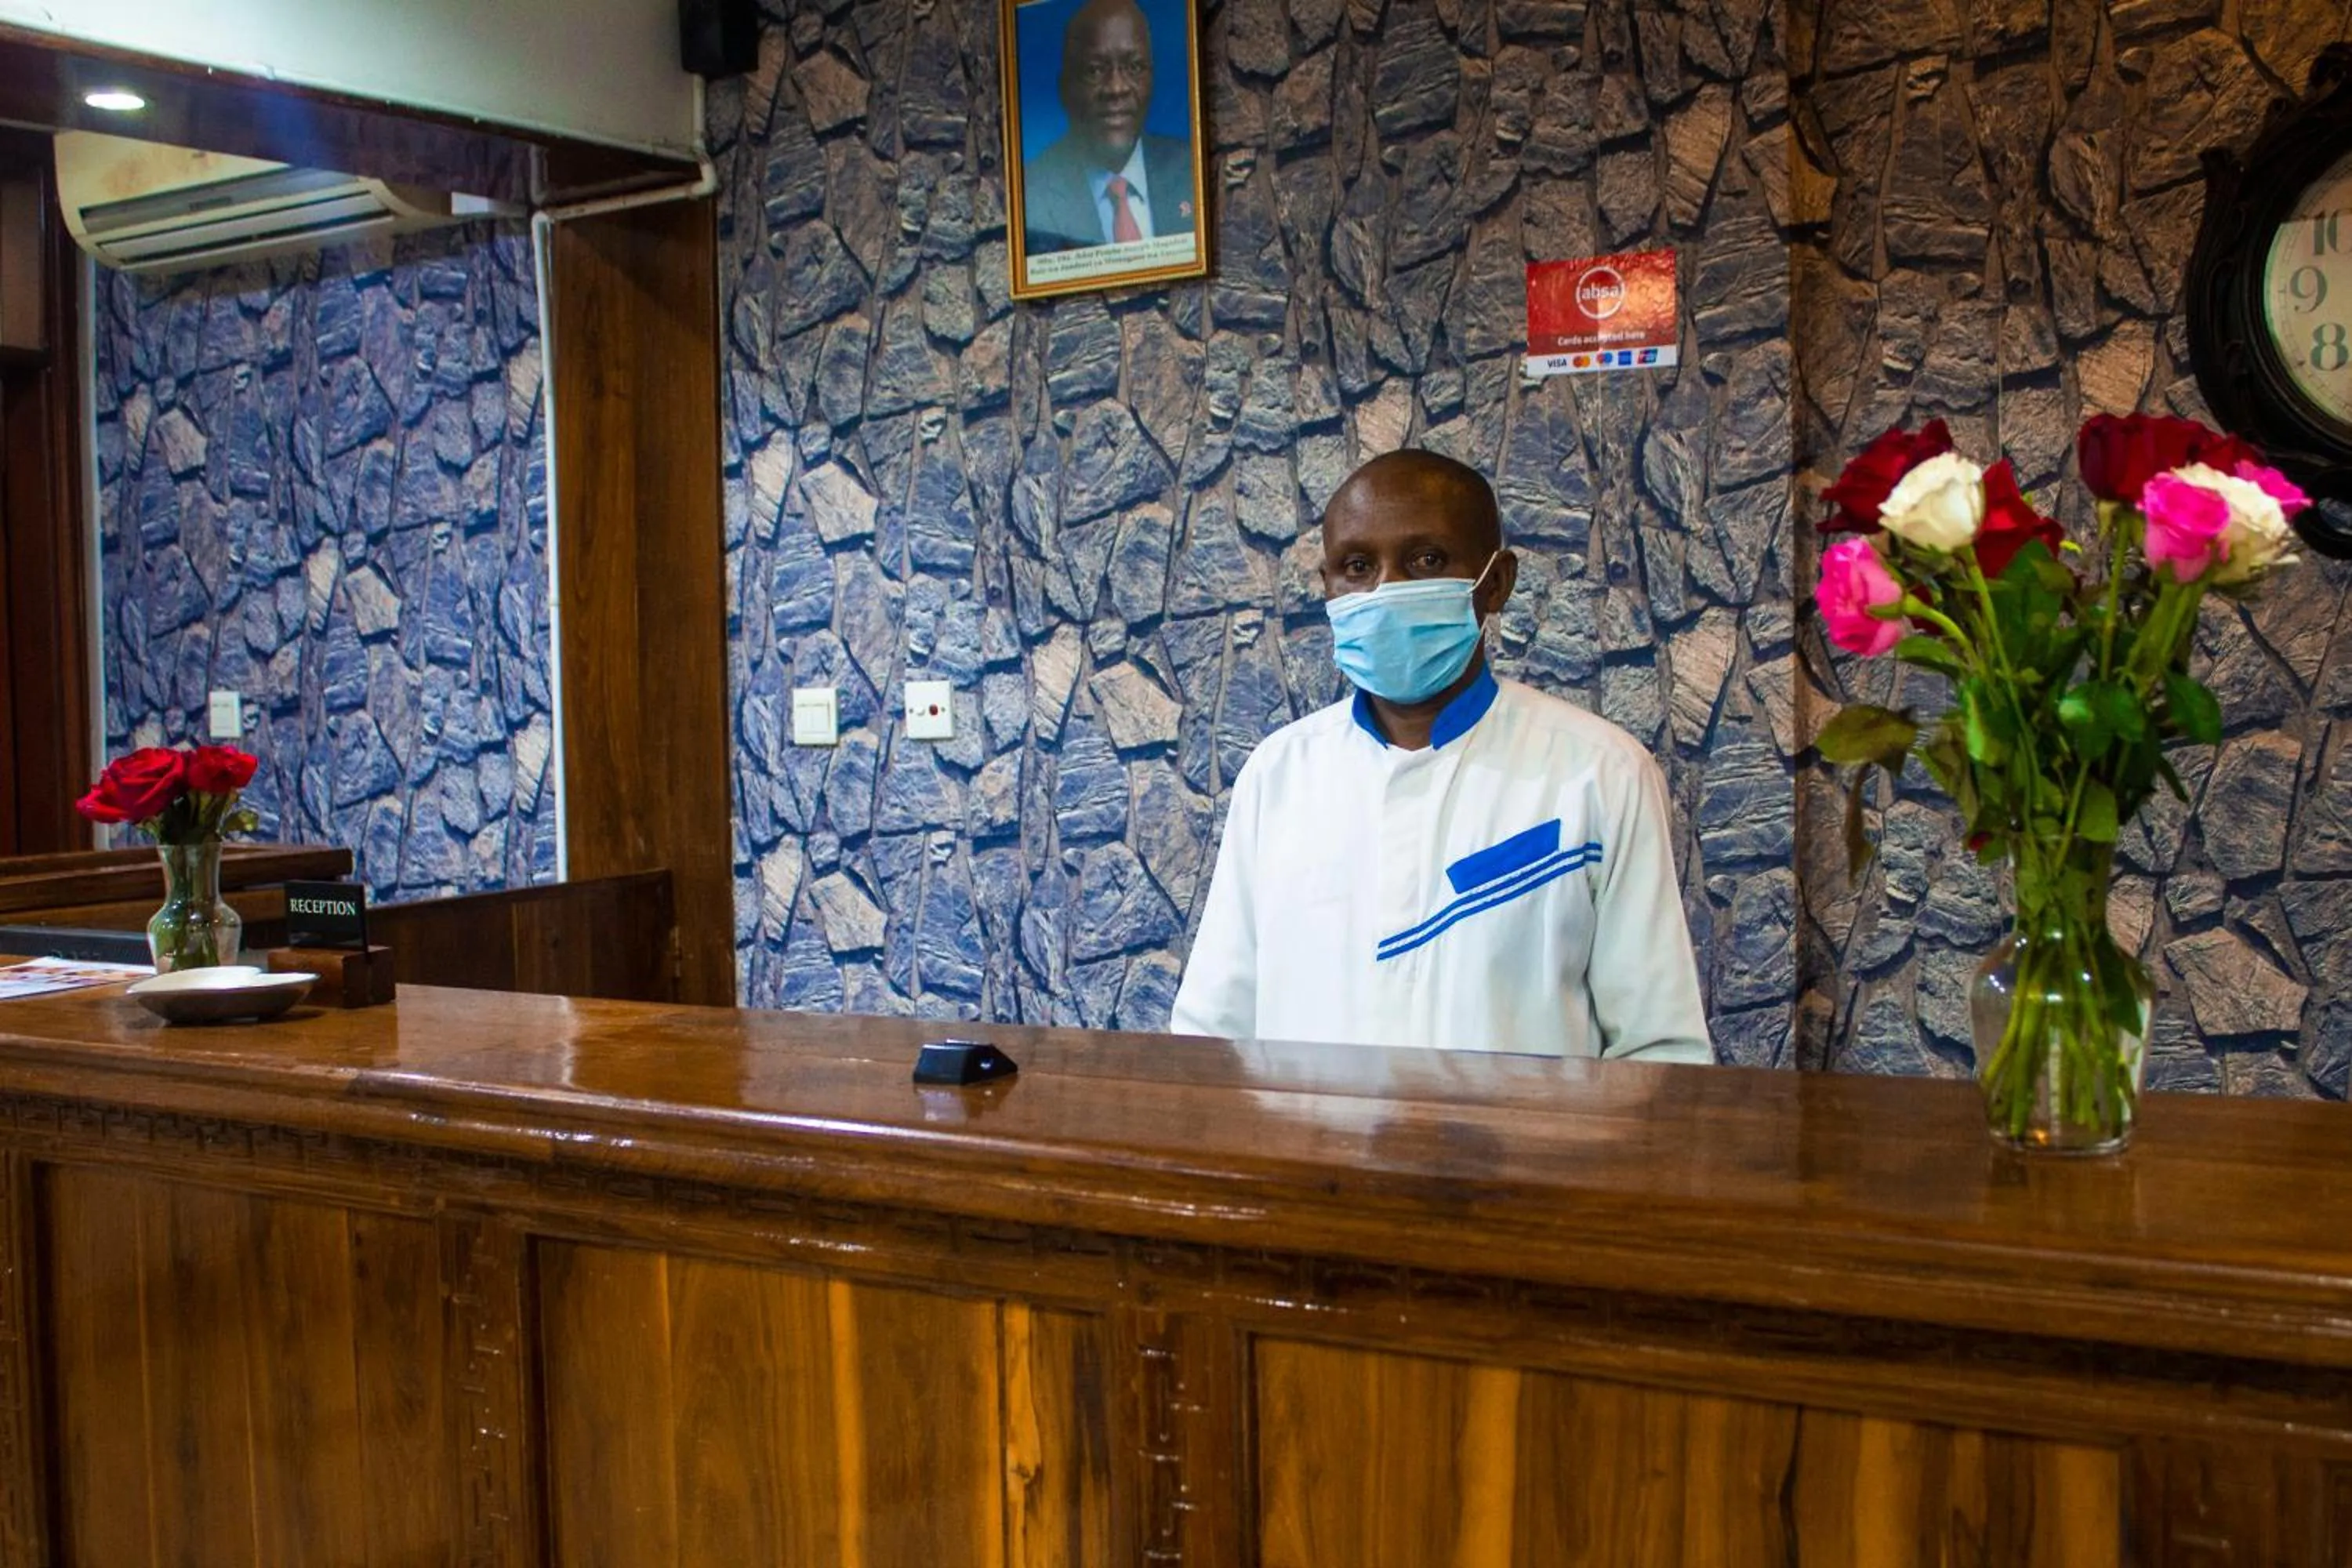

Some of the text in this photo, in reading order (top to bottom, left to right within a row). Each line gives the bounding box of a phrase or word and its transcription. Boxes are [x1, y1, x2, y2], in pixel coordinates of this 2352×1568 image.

[1581, 282, 1619, 299] absa
[2290, 266, 2328, 314] 9
[1557, 335, 1583, 346] Cards
[2310, 323, 2349, 372] 8
[1547, 358, 1567, 368] VISA
[289, 898, 356, 916] RECEPTION
